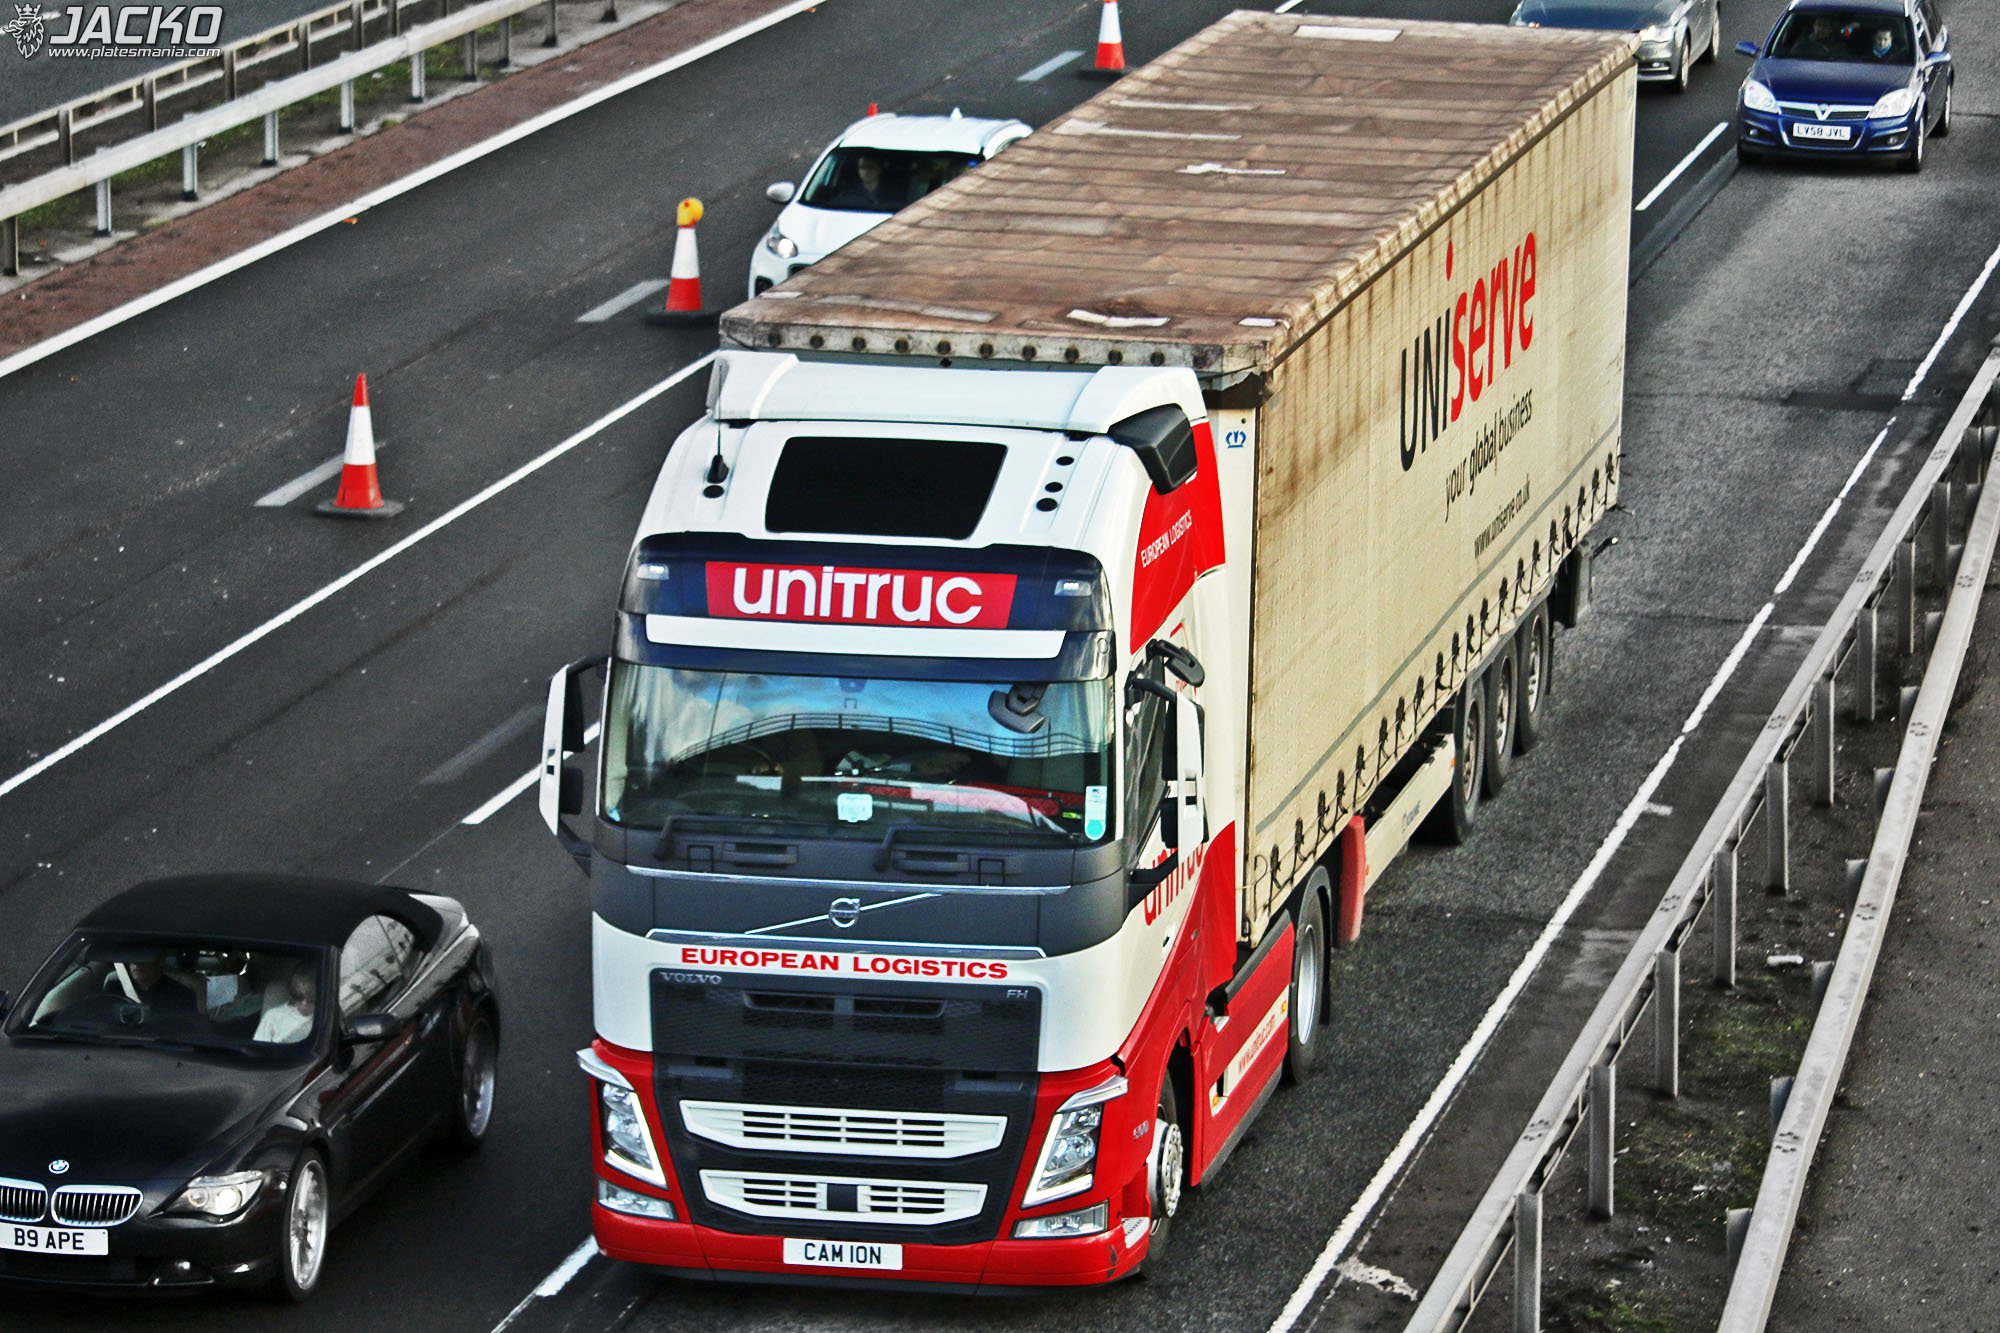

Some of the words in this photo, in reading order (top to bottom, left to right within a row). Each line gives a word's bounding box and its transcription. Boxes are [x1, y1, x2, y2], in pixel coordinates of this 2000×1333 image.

[1445, 457, 1467, 524] your
[1469, 411, 1497, 496] global
[1499, 389, 1533, 453] business
[1141, 531, 1170, 568] EUROPEAN
[1169, 509, 1192, 545] LOGISTICS
[682, 947, 839, 971] EUROPEAN
[853, 957, 1008, 980] LOGISTICS
[660, 971, 722, 985] VOLVO
[1007, 989, 1029, 999] FH
[14, 1228, 39, 1248] B9
[46, 1231, 85, 1251] APE
